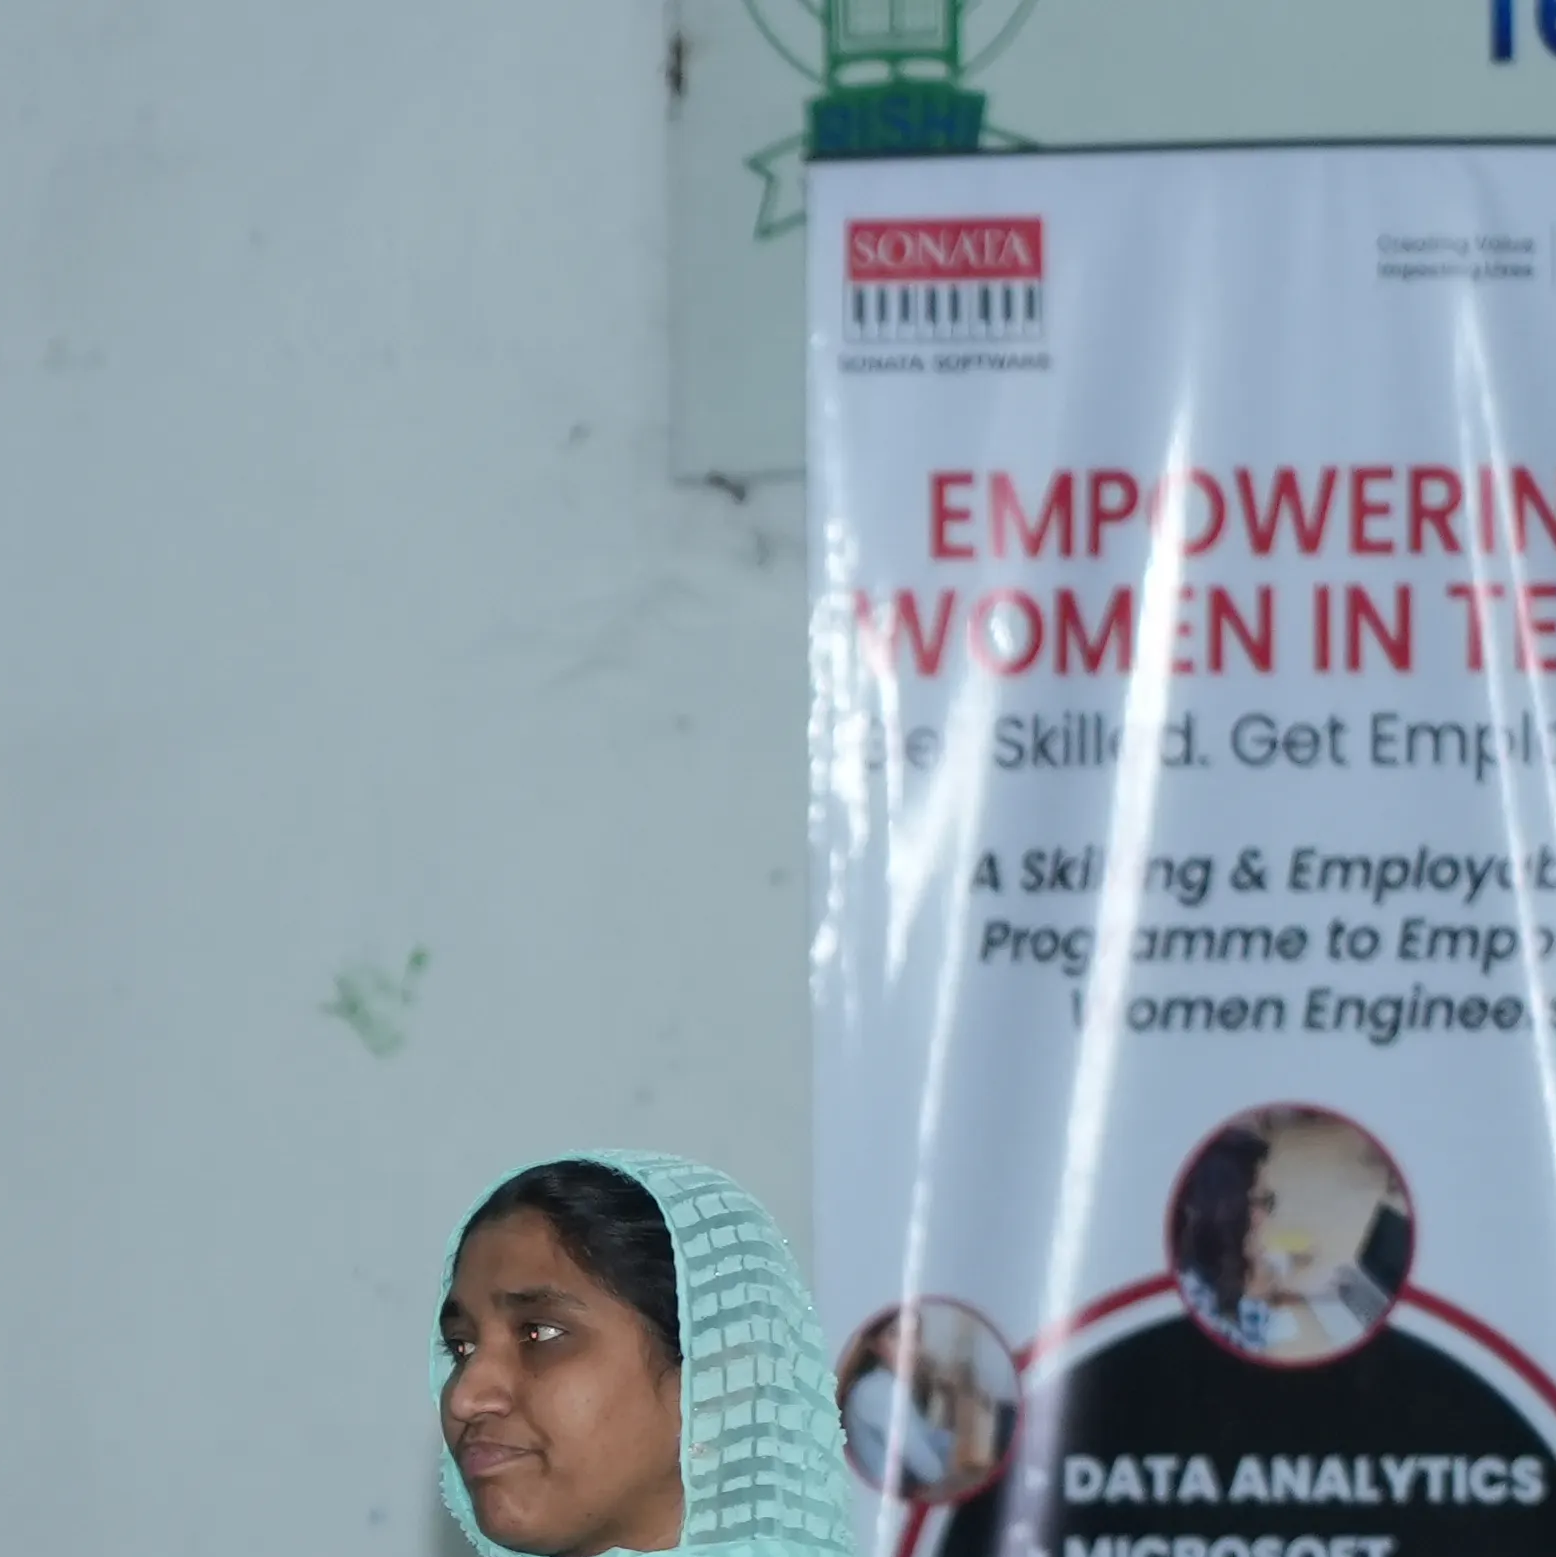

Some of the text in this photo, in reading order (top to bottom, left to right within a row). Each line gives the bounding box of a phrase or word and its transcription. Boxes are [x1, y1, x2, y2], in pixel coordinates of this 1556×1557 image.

[852, 228, 1031, 270] SONATA
[854, 586, 1276, 677] WOMEN
[1310, 584, 1412, 674] IN
[1229, 712, 1349, 769] Get
[970, 852, 1001, 891] A
[1020, 845, 1214, 906] Skilng
[1229, 845, 1268, 890] &
[979, 918, 1308, 978] Progamme
[1328, 918, 1381, 962] to
[1071, 988, 1286, 1033] omen
[1062, 1455, 1548, 1503] DATA ANALYTICS
